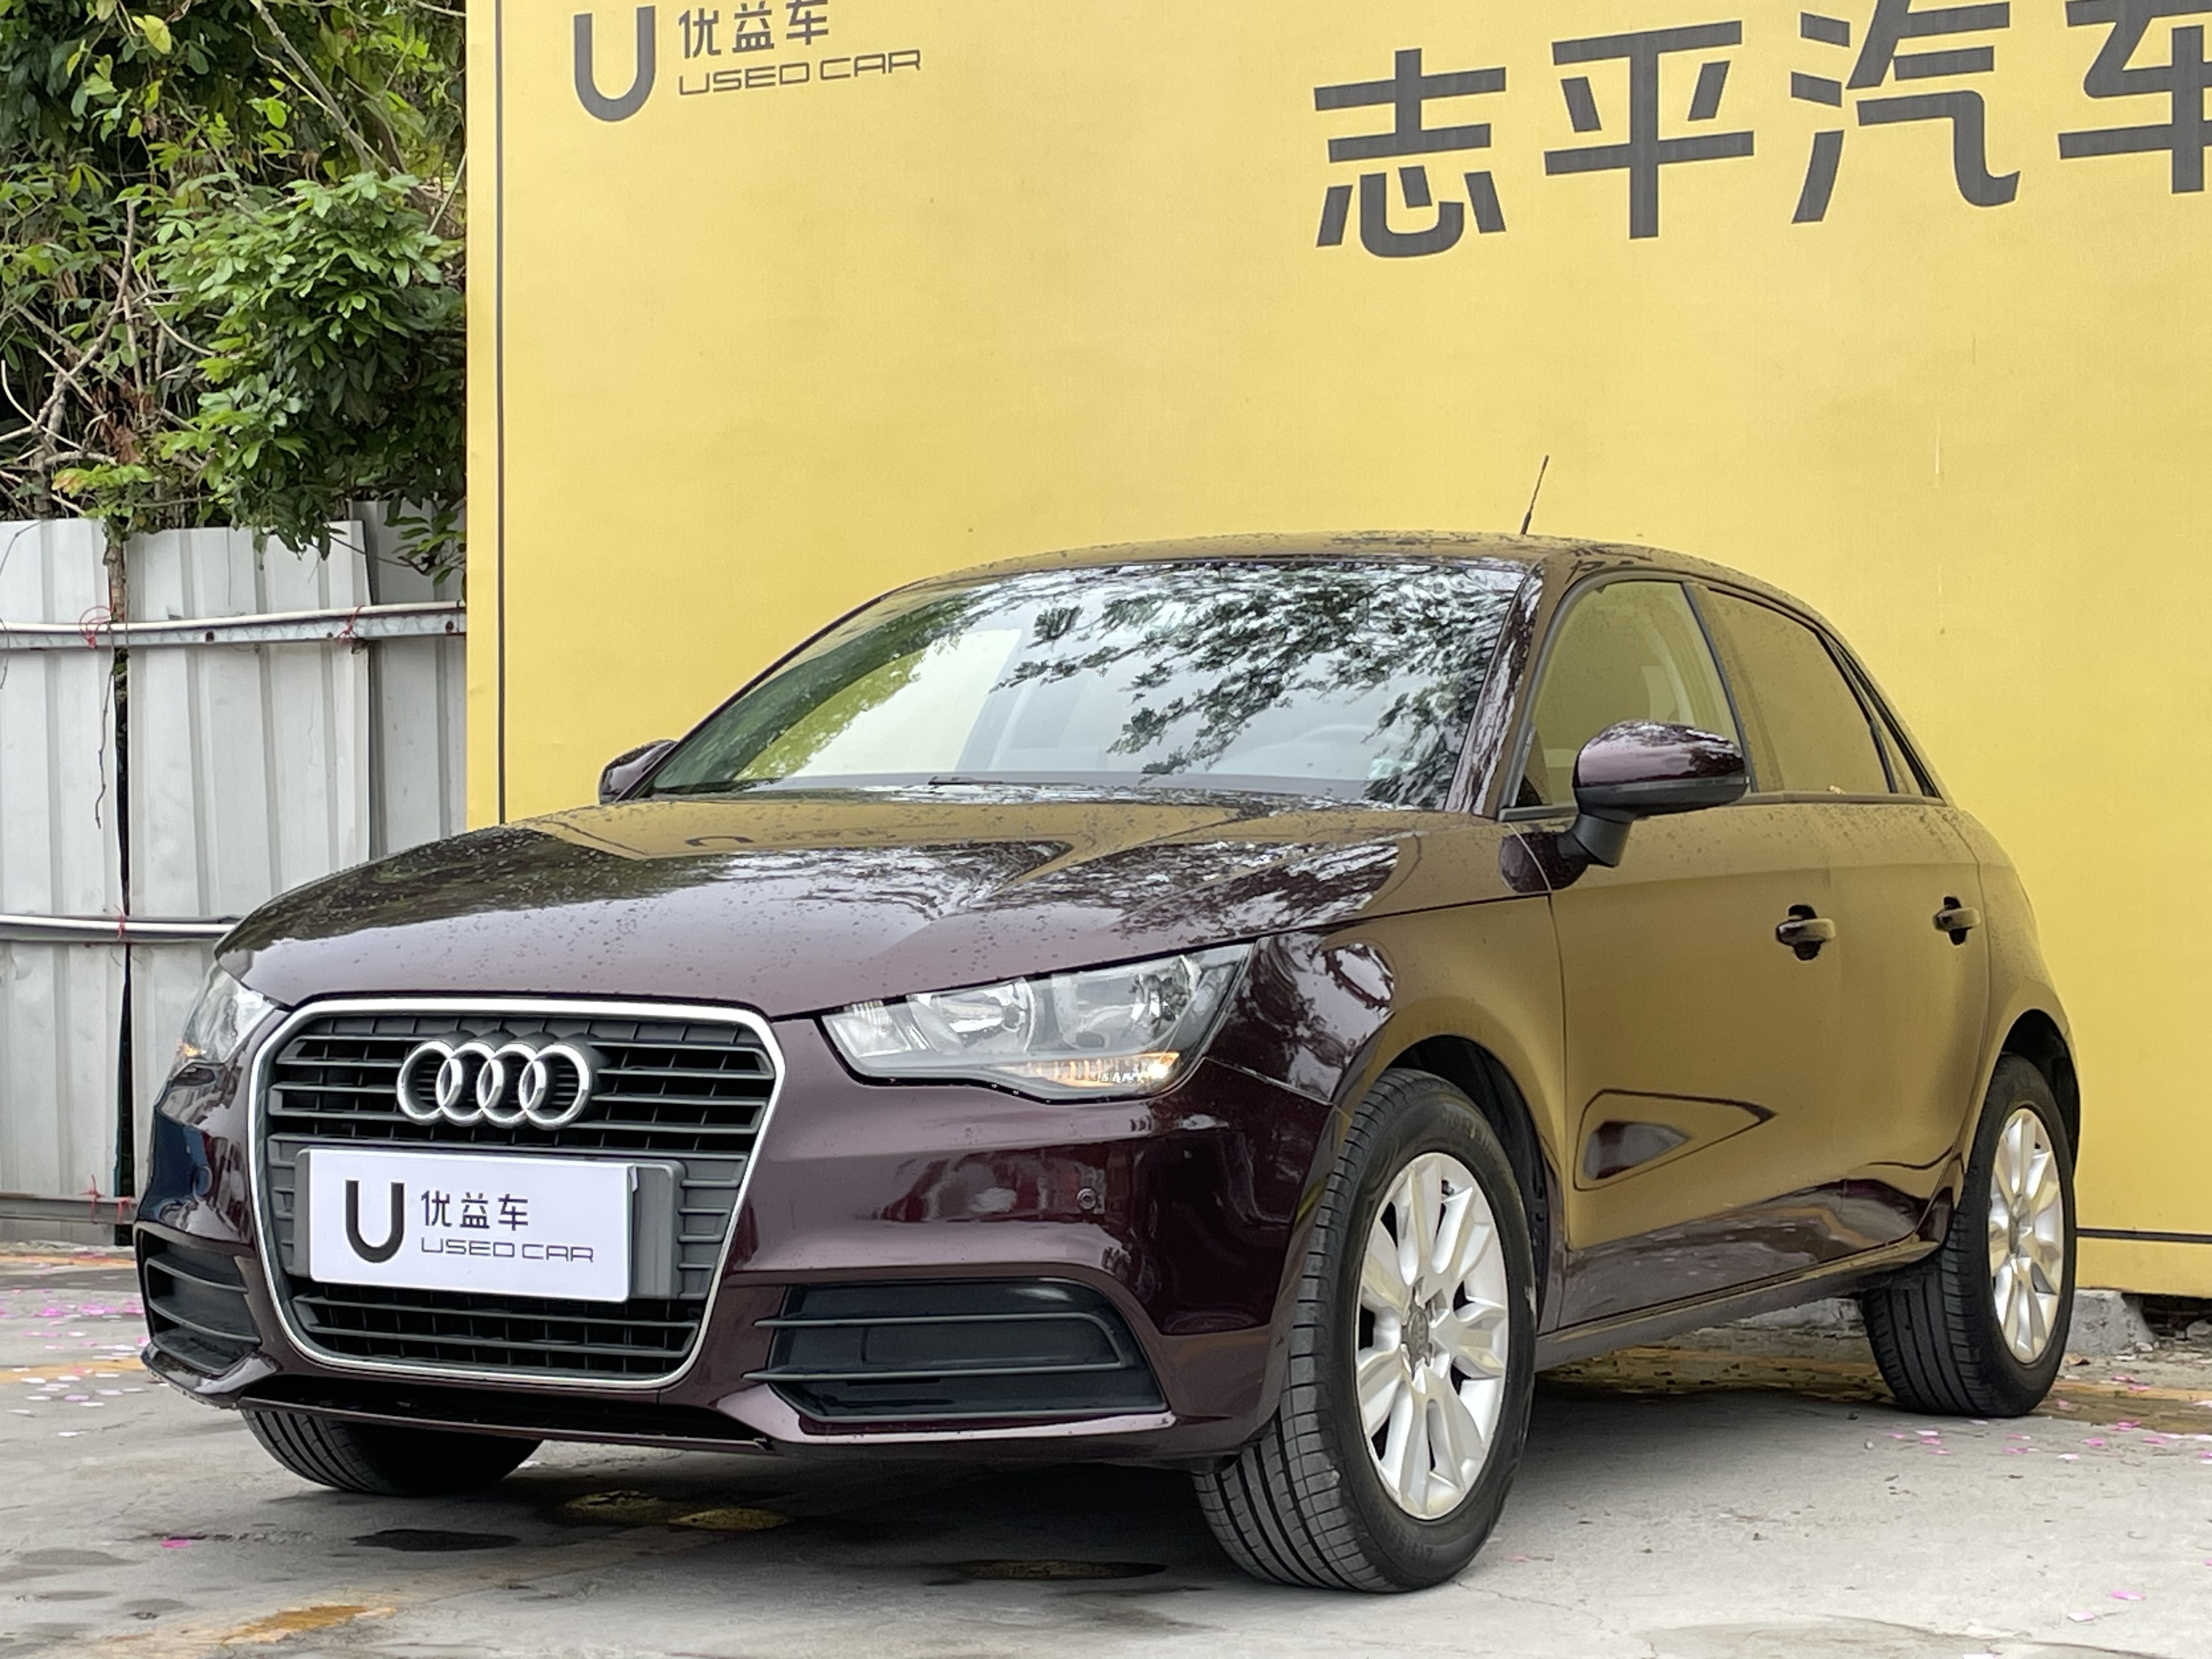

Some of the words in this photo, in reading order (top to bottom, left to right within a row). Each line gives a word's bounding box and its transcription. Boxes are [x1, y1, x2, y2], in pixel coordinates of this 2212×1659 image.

[678, 0, 829, 59] 优益车
[574, 5, 656, 122] U
[679, 62, 810, 96] USED
[819, 49, 922, 81] CAR
[1313, 0, 2212, 258] 志平汽车
[346, 1180, 405, 1263] U
[421, 1190, 528, 1232] 优益车
[421, 1237, 515, 1259] USED
[522, 1243, 594, 1263] CAR
